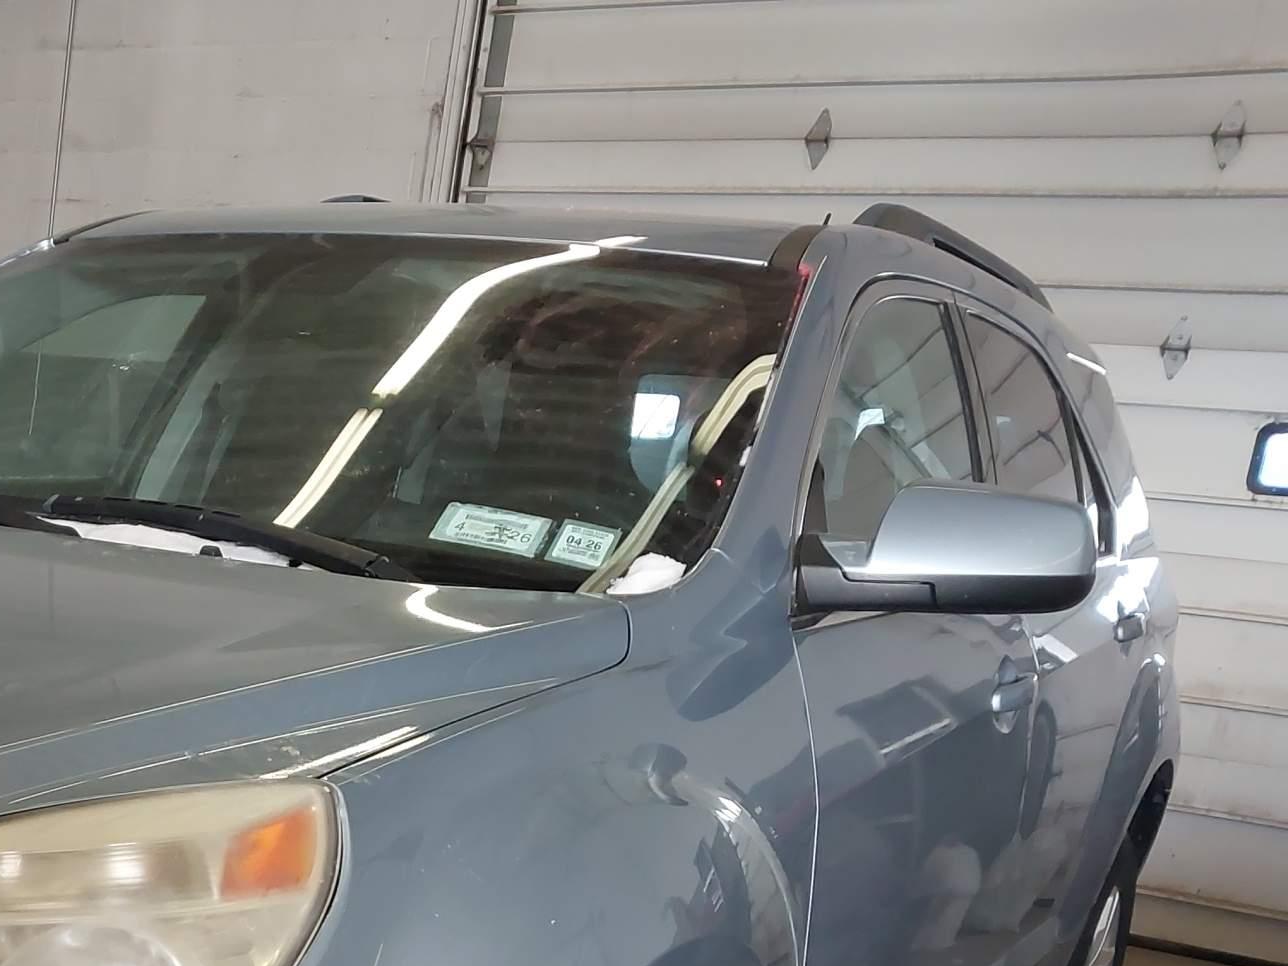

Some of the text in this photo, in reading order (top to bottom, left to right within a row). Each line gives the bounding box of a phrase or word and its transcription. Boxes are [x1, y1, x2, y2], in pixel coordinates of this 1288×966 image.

[454, 521, 465, 532] 4
[511, 530, 532, 544] 26
[566, 535, 602, 550] 04 26
